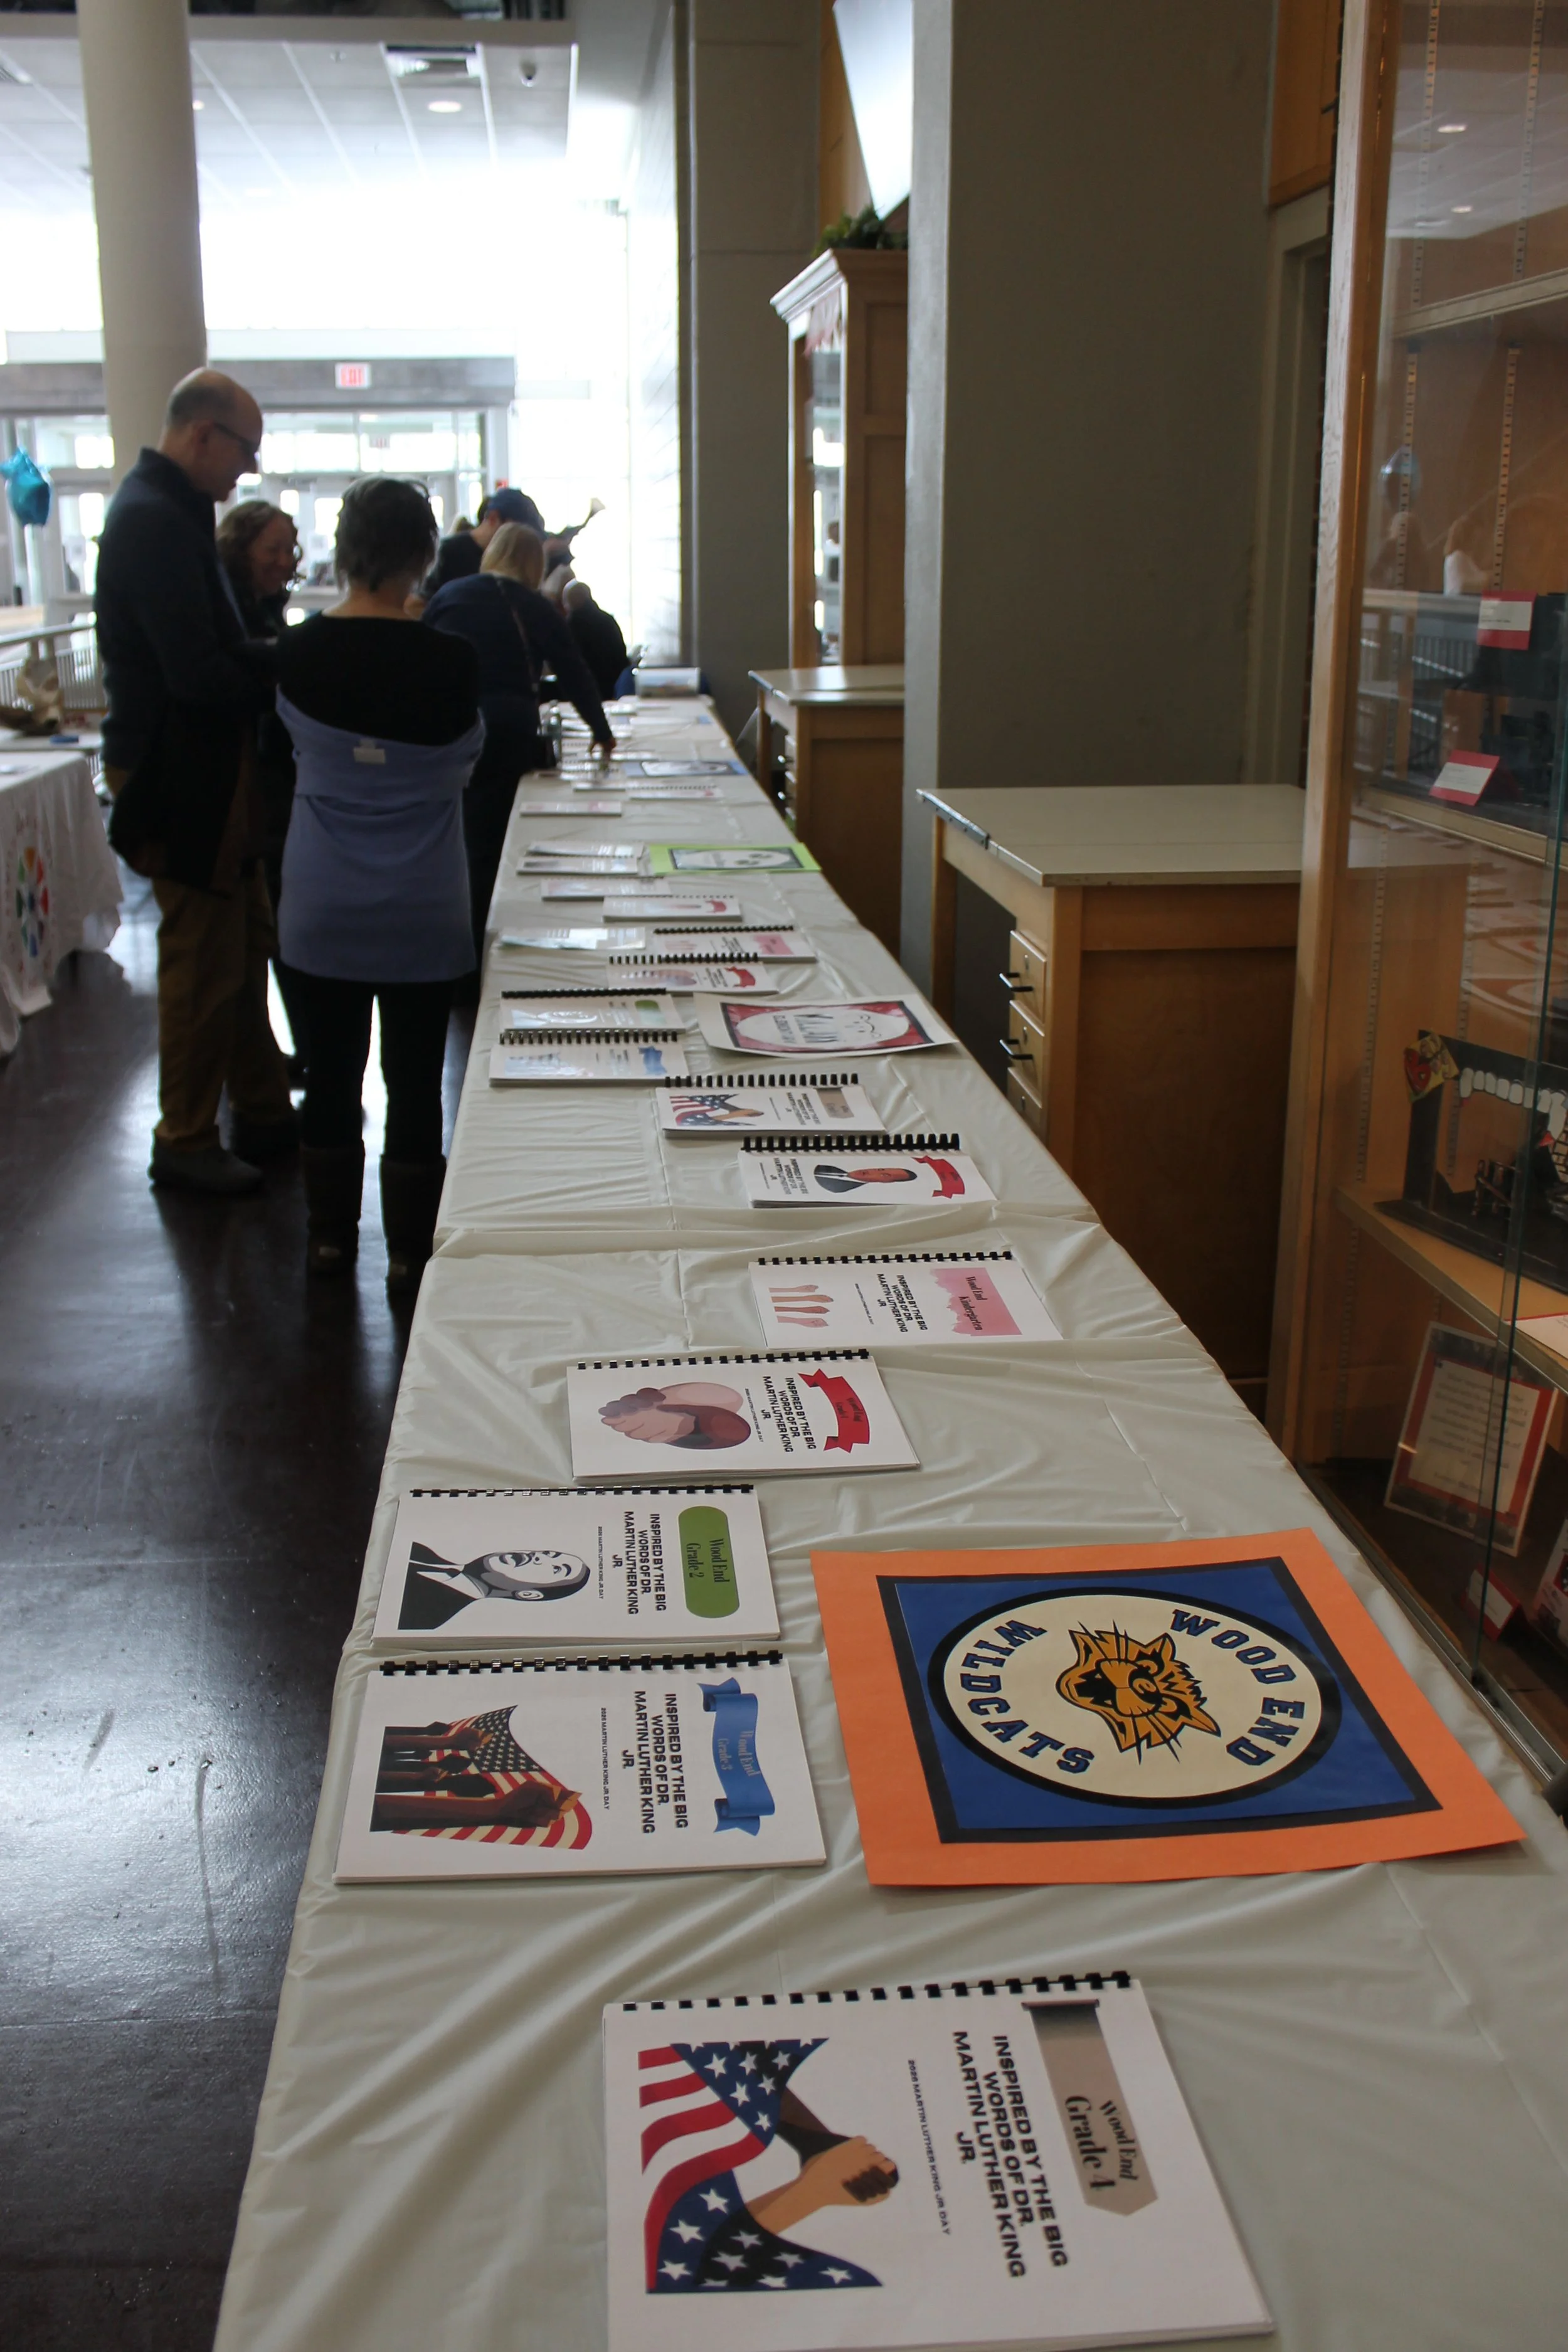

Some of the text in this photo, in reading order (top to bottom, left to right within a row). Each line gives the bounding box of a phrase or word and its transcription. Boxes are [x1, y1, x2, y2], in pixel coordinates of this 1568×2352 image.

[877, 1274, 908, 1333] MARTIN LUTHER KING
[891, 1285, 906, 1304] WORDS
[897, 1274, 914, 1300] INSPIRED
[912, 1309, 923, 1320] THE
[916, 1320, 928, 1330] BIG
[958, 1296, 983, 1330] Kindergarten
[762, 1376, 793, 1453] MARTIN LUTHER KING
[778, 1391, 793, 1416] WORDS
[787, 1416, 797, 1426] OF
[785, 1377, 817, 1449] INSPIRED BY THE BIG
[624, 1511, 638, 1615] MARTIN LUTHER KING
[638, 1530, 650, 1564] WORDS
[650, 1513, 667, 1611] INSPIRED BY THE BIG
[686, 1542, 704, 1571] Grade
[709, 1538, 730, 1583] Wood End
[639, 1565, 650, 1579] OF
[960, 1619, 1094, 1774] WILDCATS
[1170, 1609, 1305, 1766] WOOD END
[651, 1714, 665, 1764] WORDS
[634, 1691, 655, 1834] MARTIN LUTHER KING
[655, 1765, 667, 1783] OF
[665, 1693, 688, 1828] INSPIRED BY THE BIG
[740, 1756, 761, 1777] End
[603, 1786, 609, 1795] JR
[913, 2084, 926, 2122] MARTIN
[921, 2124, 935, 2163] LUTHER
[953, 2031, 1026, 2278] MARTIN LUTHER KING
[956, 2131, 976, 2164] JR.
[983, 2071, 1034, 2227] WORDS OF DR.
[993, 2035, 1068, 2267] INSPIRED BY THE BIG
[1065, 2095, 1116, 2190] Grade 4
[1099, 2100, 1138, 2181] Wood End
[929, 2164, 941, 2191] KING
[935, 2193, 945, 2208] JR
[938, 2211, 951, 2235] DAY
